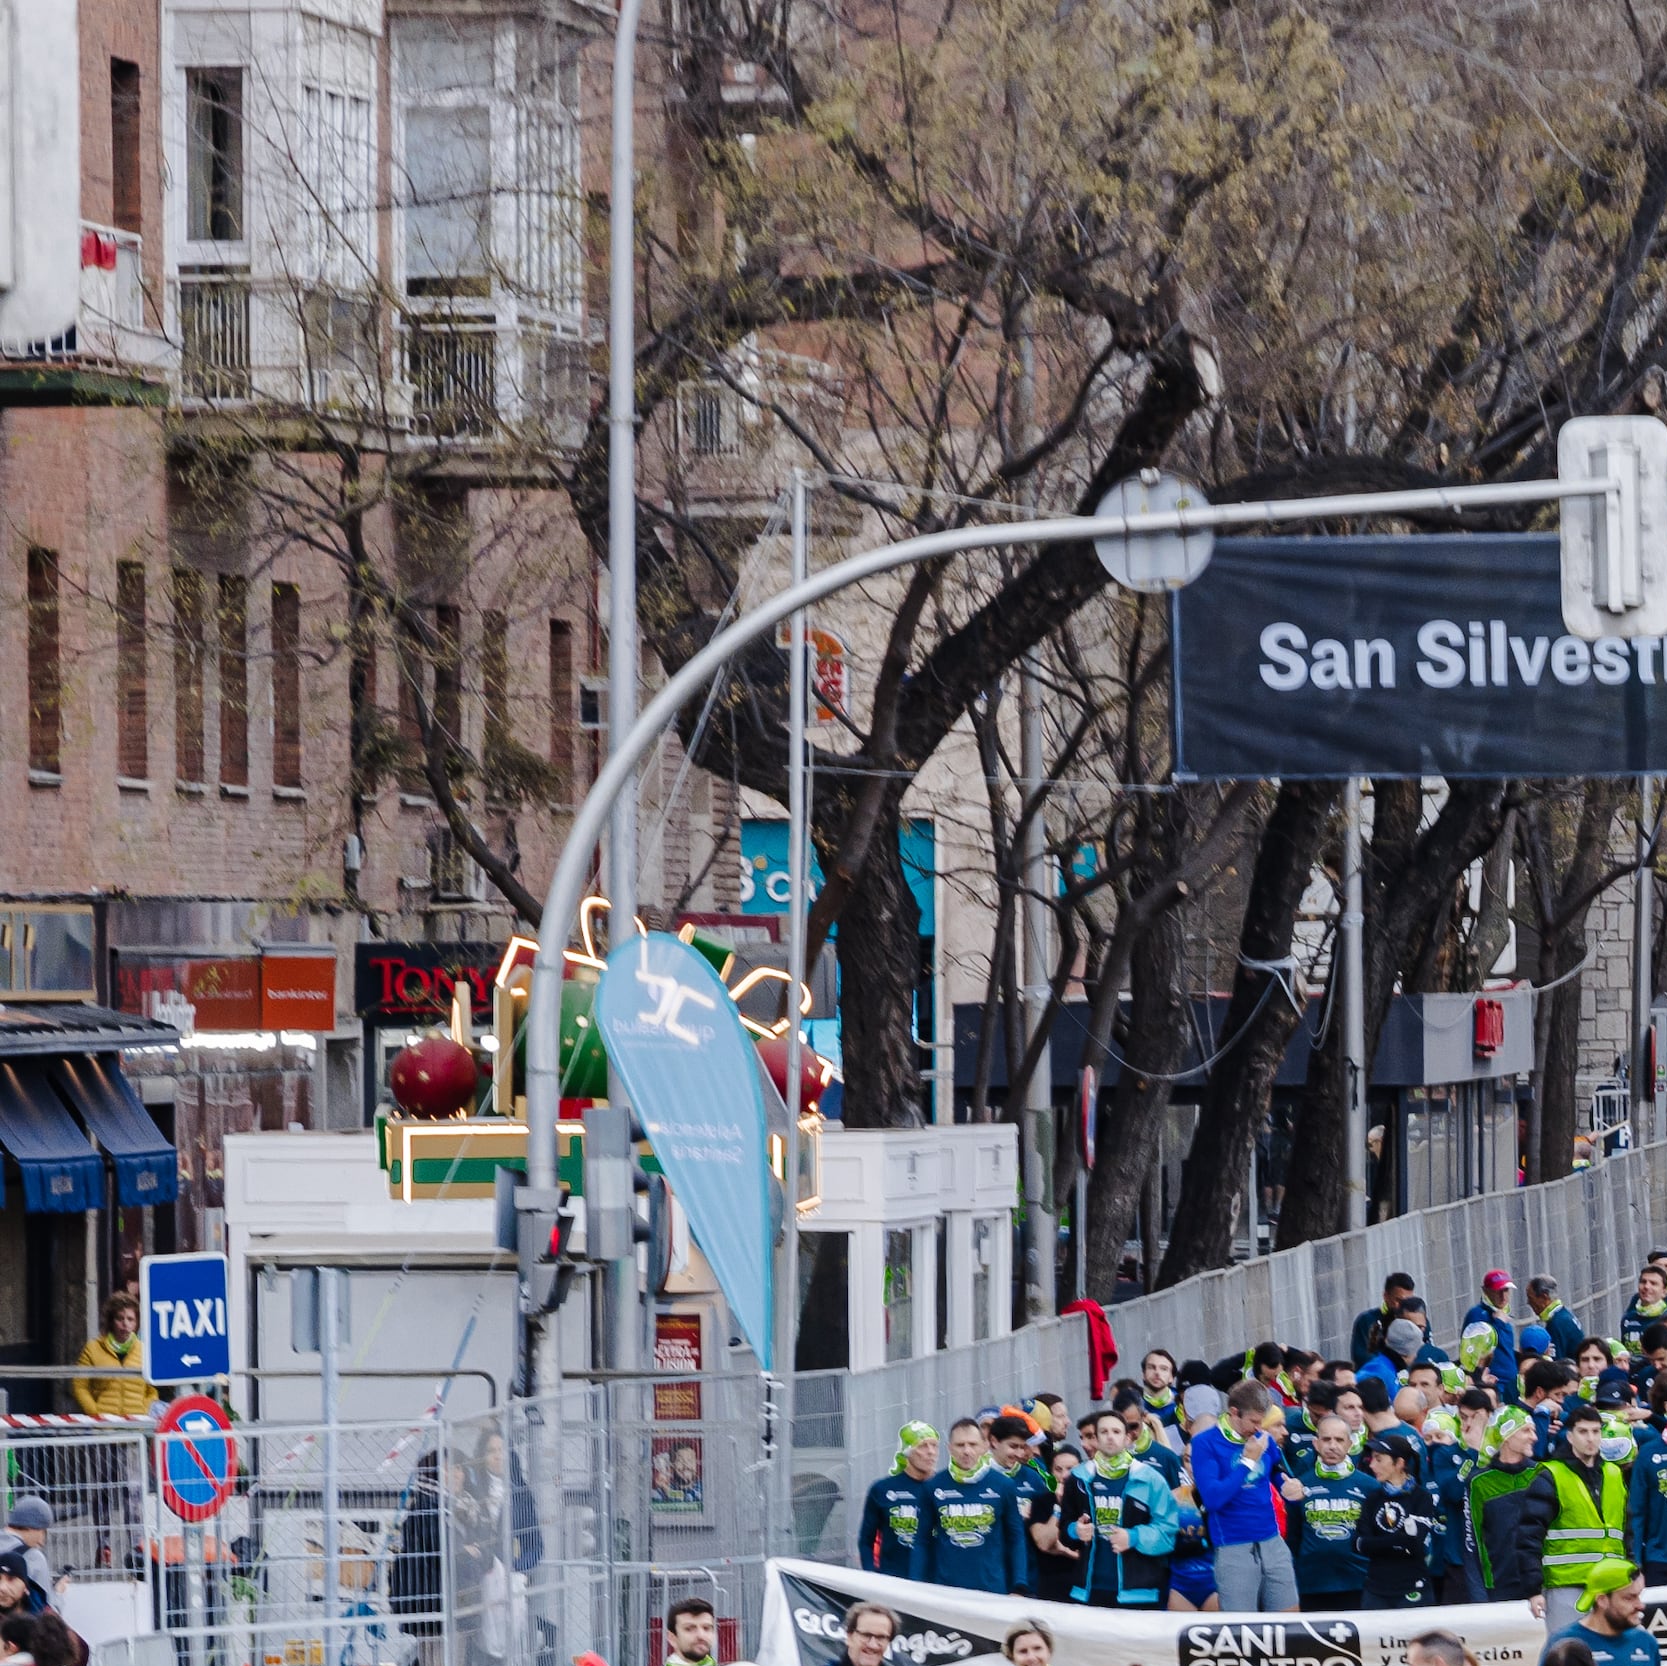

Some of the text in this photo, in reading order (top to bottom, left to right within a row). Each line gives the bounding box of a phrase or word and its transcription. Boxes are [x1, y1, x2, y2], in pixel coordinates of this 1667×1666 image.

[1259, 621, 1396, 692] San
[370, 958, 498, 1003] TONY
[153, 1299, 226, 1339] TAXI
[1186, 1624, 1286, 1658] SANI
